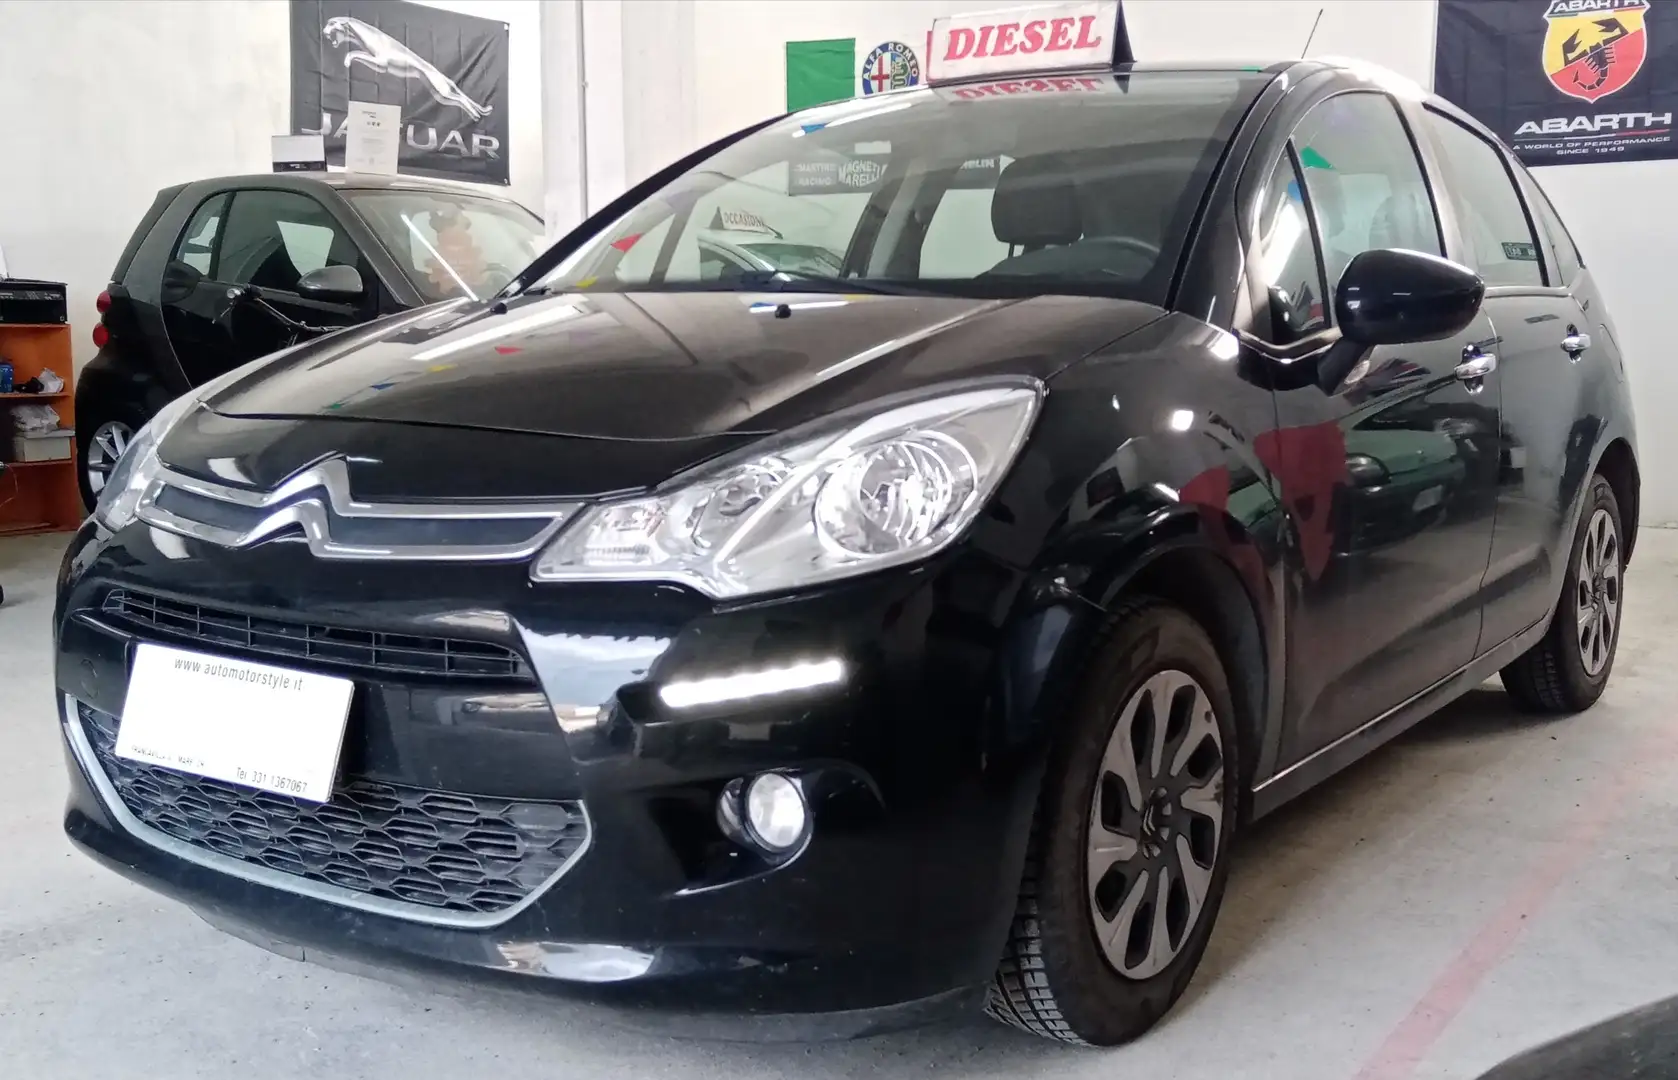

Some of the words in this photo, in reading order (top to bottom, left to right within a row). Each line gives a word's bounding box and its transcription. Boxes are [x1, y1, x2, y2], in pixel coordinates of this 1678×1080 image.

[943, 15, 1102, 61] DIESEL
[863, 47, 883, 79] ALFA
[888, 42, 918, 77] ROMEO
[1514, 112, 1673, 135] ABARTH
[1584, 136, 1671, 147] PERFORMANCE
[252, 770, 267, 783] 331
